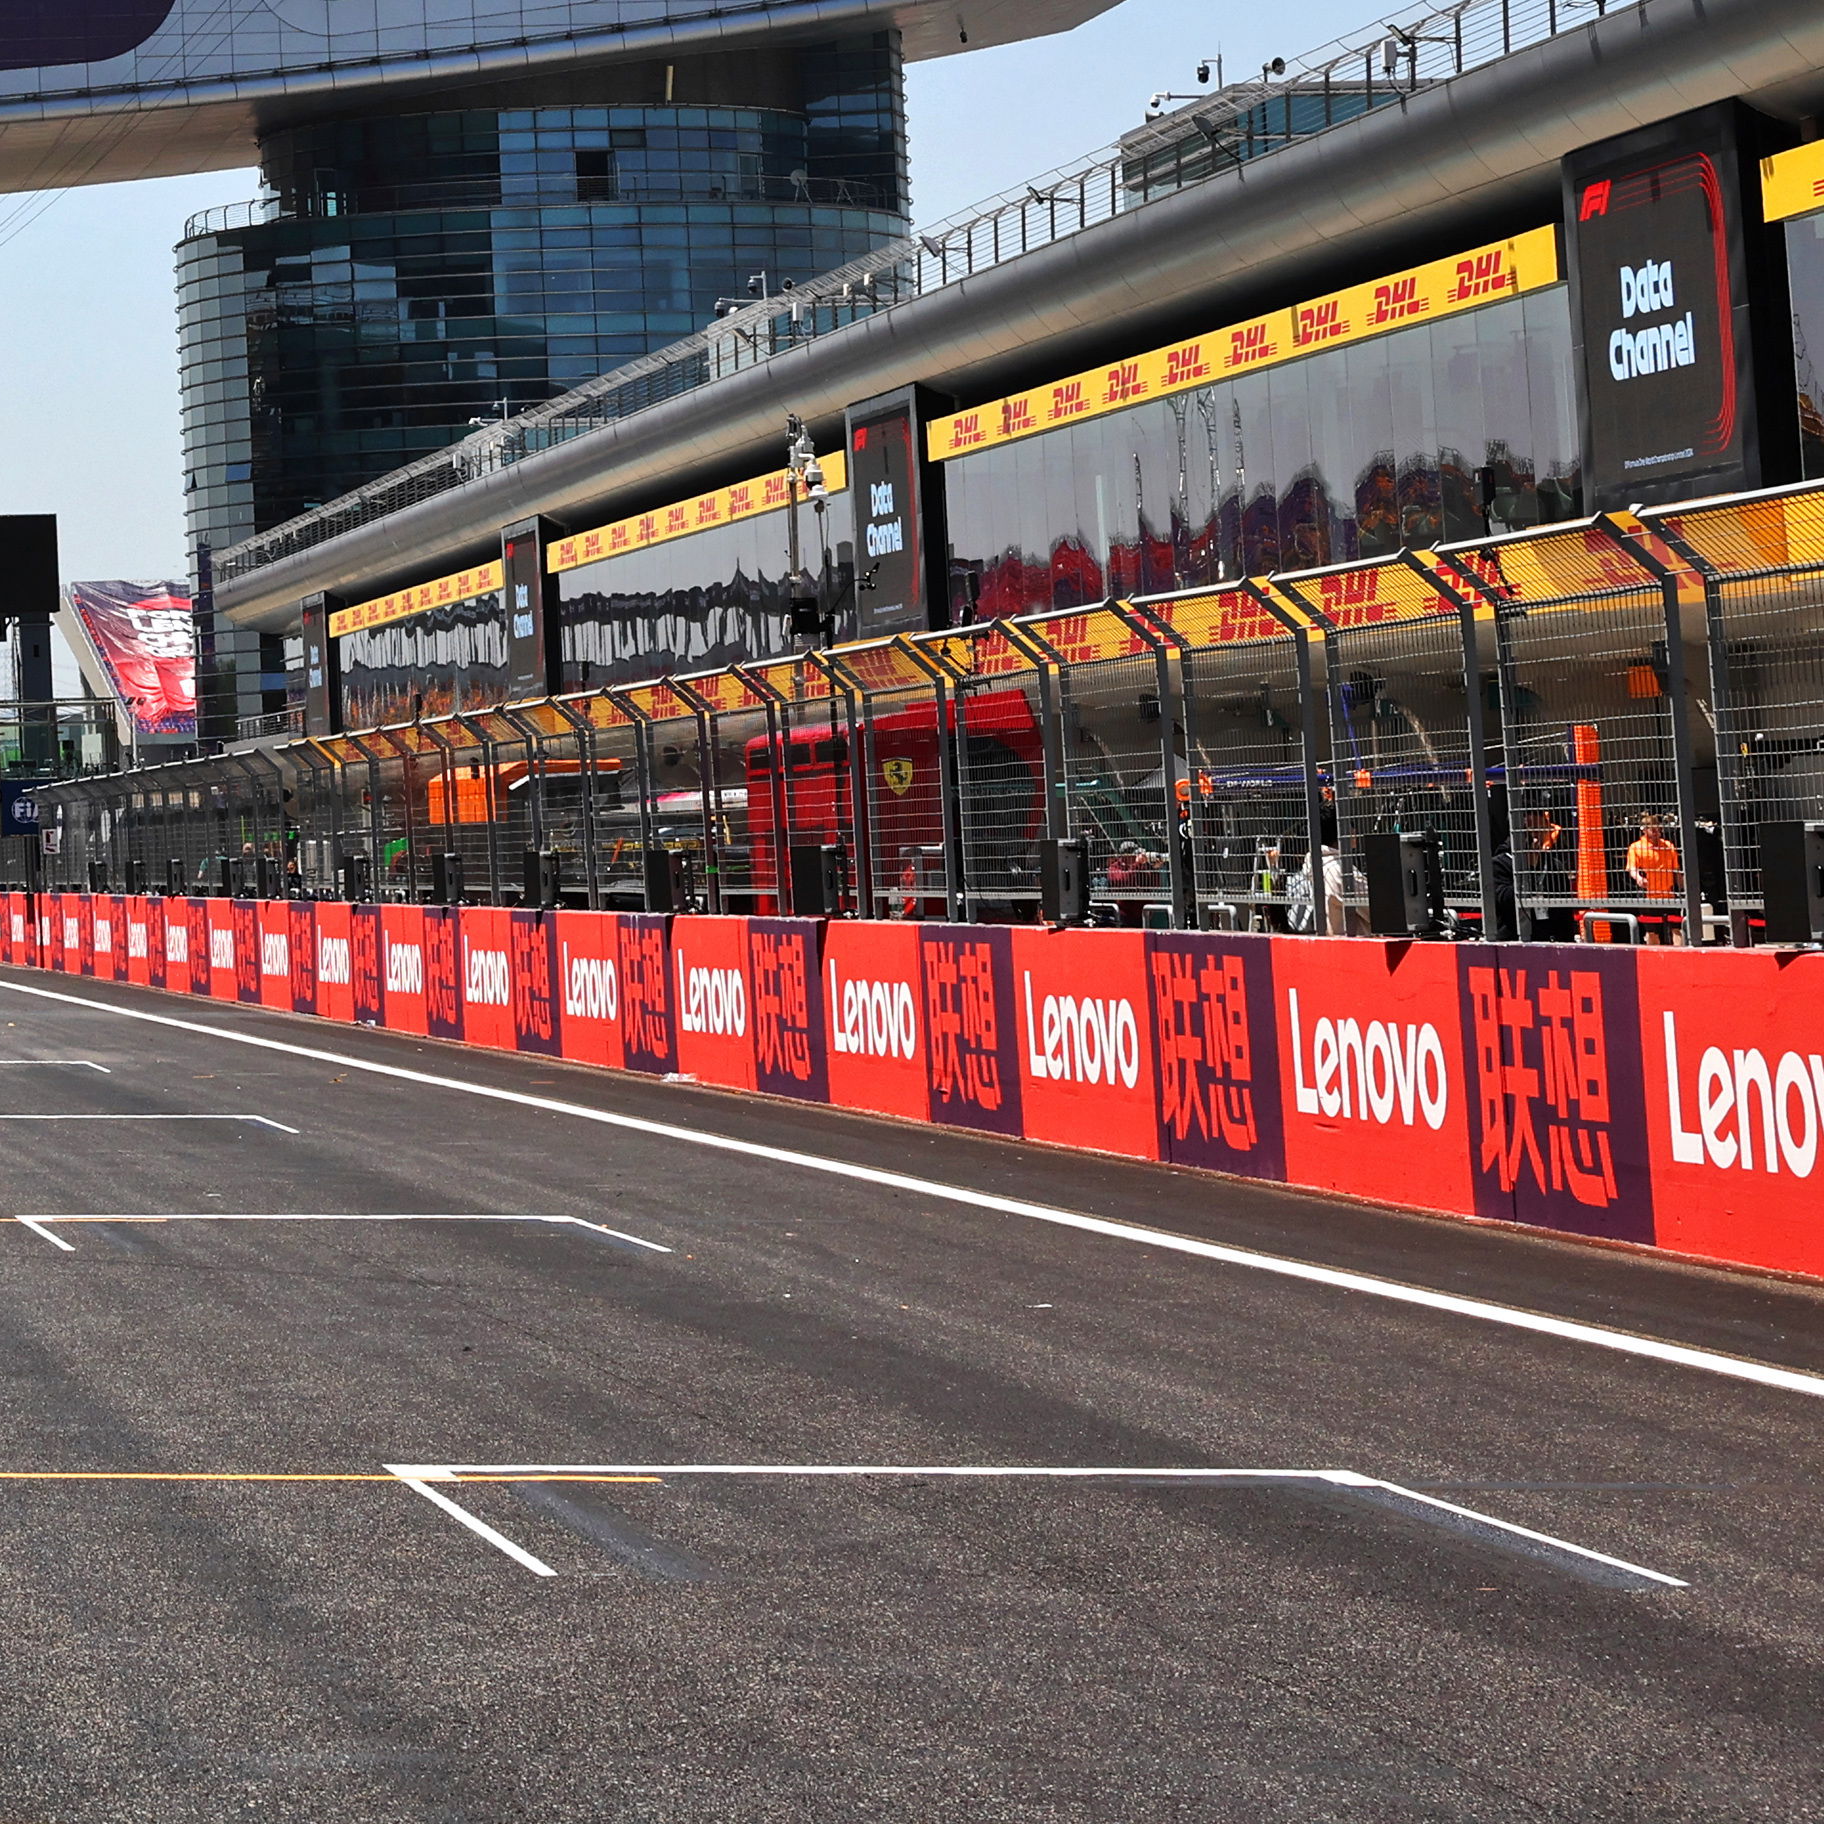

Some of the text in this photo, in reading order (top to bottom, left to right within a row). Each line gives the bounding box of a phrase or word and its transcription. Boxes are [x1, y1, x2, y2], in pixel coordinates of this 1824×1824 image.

[1370, 277, 1424, 325] DHL
[1450, 251, 1510, 303] DHL
[1620, 259, 1674, 318] Data
[1230, 324, 1273, 366] DHL
[1299, 301, 1345, 347] DHL
[1609, 312, 1696, 381] Channel
[1106, 364, 1145, 403] DHL
[1164, 345, 1207, 385] DHL
[999, 399, 1034, 434] DHL
[1051, 382, 1086, 418] DHL
[951, 414, 984, 448] DHL
[870, 481, 894, 517] Data
[866, 517, 903, 557] Channel
[164, 914, 188, 964] Lenovo
[208, 918, 235, 970] Lenovo
[259, 921, 289, 977] Lenovo
[317, 924, 350, 985] Lenovo
[384, 929, 423, 995] Lenovo
[463, 934, 510, 1007] Lenovo
[563, 941, 617, 1021] Lenovo
[620, 927, 669, 1059] 联想
[677, 948, 746, 1038] Lenovo
[752, 932, 812, 1081] 联想
[829, 958, 916, 1060] Lenovo
[923, 941, 1003, 1111] 联想
[1024, 970, 1139, 1089] Lenovo
[1152, 951, 1259, 1151] 联想
[1288, 987, 1447, 1130] Lenovo
[1467, 966, 1620, 1208] 联想
